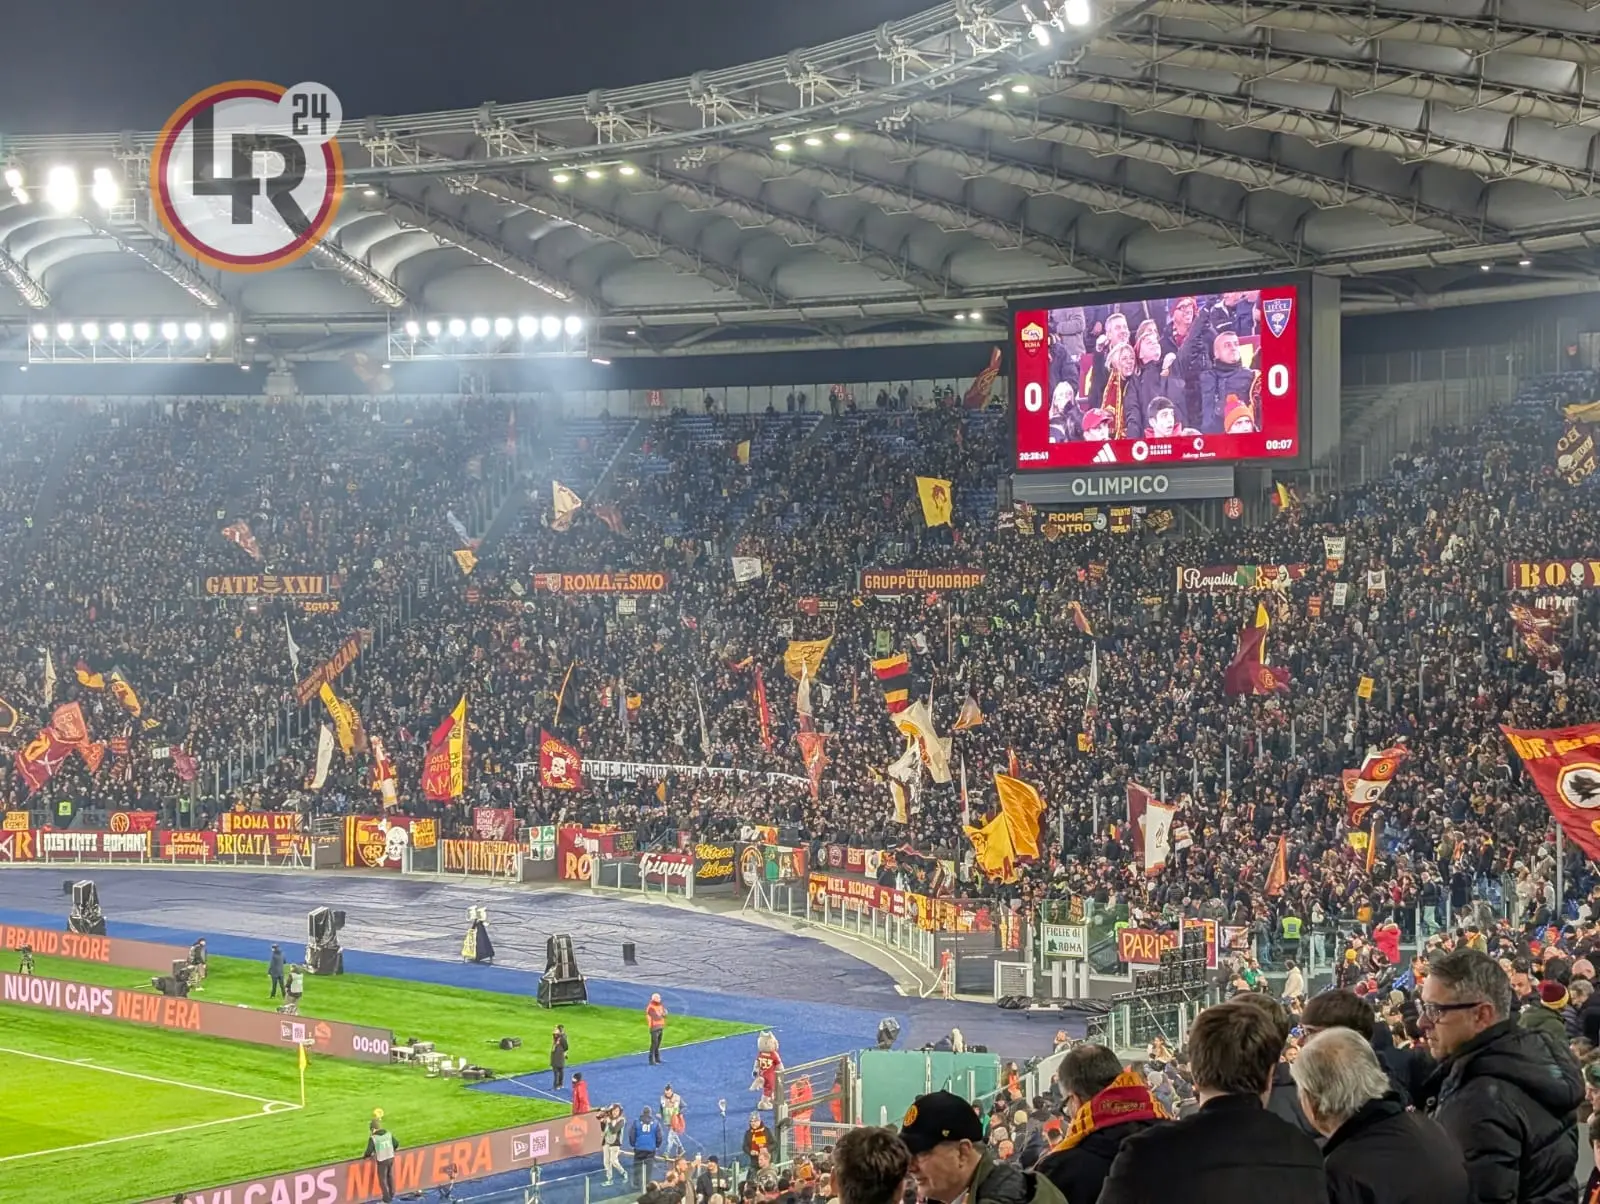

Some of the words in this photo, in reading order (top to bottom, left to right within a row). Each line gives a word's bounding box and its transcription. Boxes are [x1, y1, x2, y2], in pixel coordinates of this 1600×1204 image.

[1268, 364, 1288, 397] 0
[1024, 382, 1042, 412] 0
[1266, 440, 1293, 450] 00:07
[1071, 474, 1170, 496] OLIMPICO
[1049, 512, 1084, 522] ROMA
[1040, 523, 1092, 534] CNTRO
[206, 576, 259, 594] GATE
[280, 576, 324, 594] XXII
[233, 815, 270, 830] ROMA
[216, 833, 271, 856] BRIGATA
[6, 926, 58, 954] BRAND
[61, 933, 111, 962] STORE
[4, 974, 60, 1008] NUOVI
[65, 983, 113, 1015] CAPS
[116, 991, 160, 1024] NEW
[163, 998, 201, 1030] ERA
[352, 1035, 389, 1055] 00:00
[244, 1168, 338, 1204] CAPS
[346, 1149, 425, 1201] NW
[431, 1136, 493, 1183] ERA
